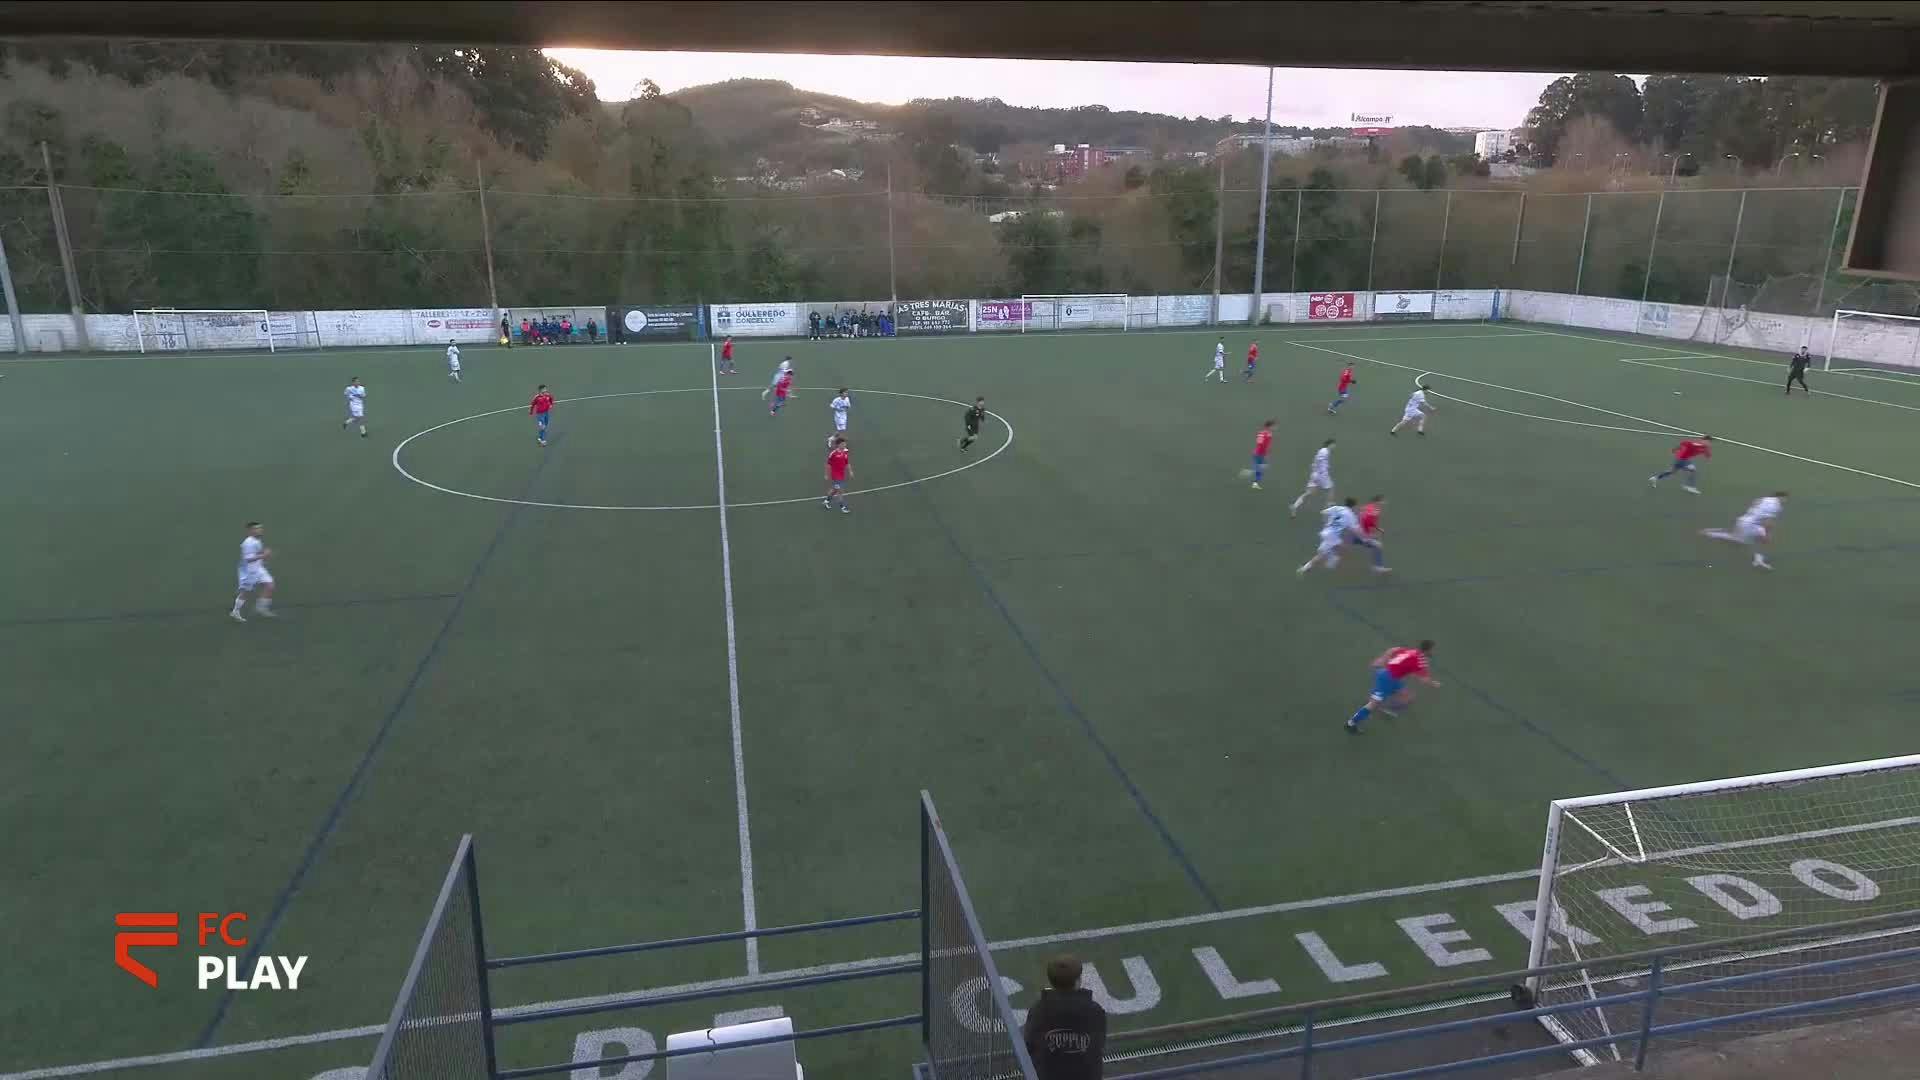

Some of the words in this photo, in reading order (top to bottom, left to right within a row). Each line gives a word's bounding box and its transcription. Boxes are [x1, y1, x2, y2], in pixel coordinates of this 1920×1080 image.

[910, 301, 930, 310] TRES
[932, 301, 965, 312] MARIAS
[735, 310, 786, 318] CULLEREDO
[951, 858, 1880, 1032] CULLEREDO
